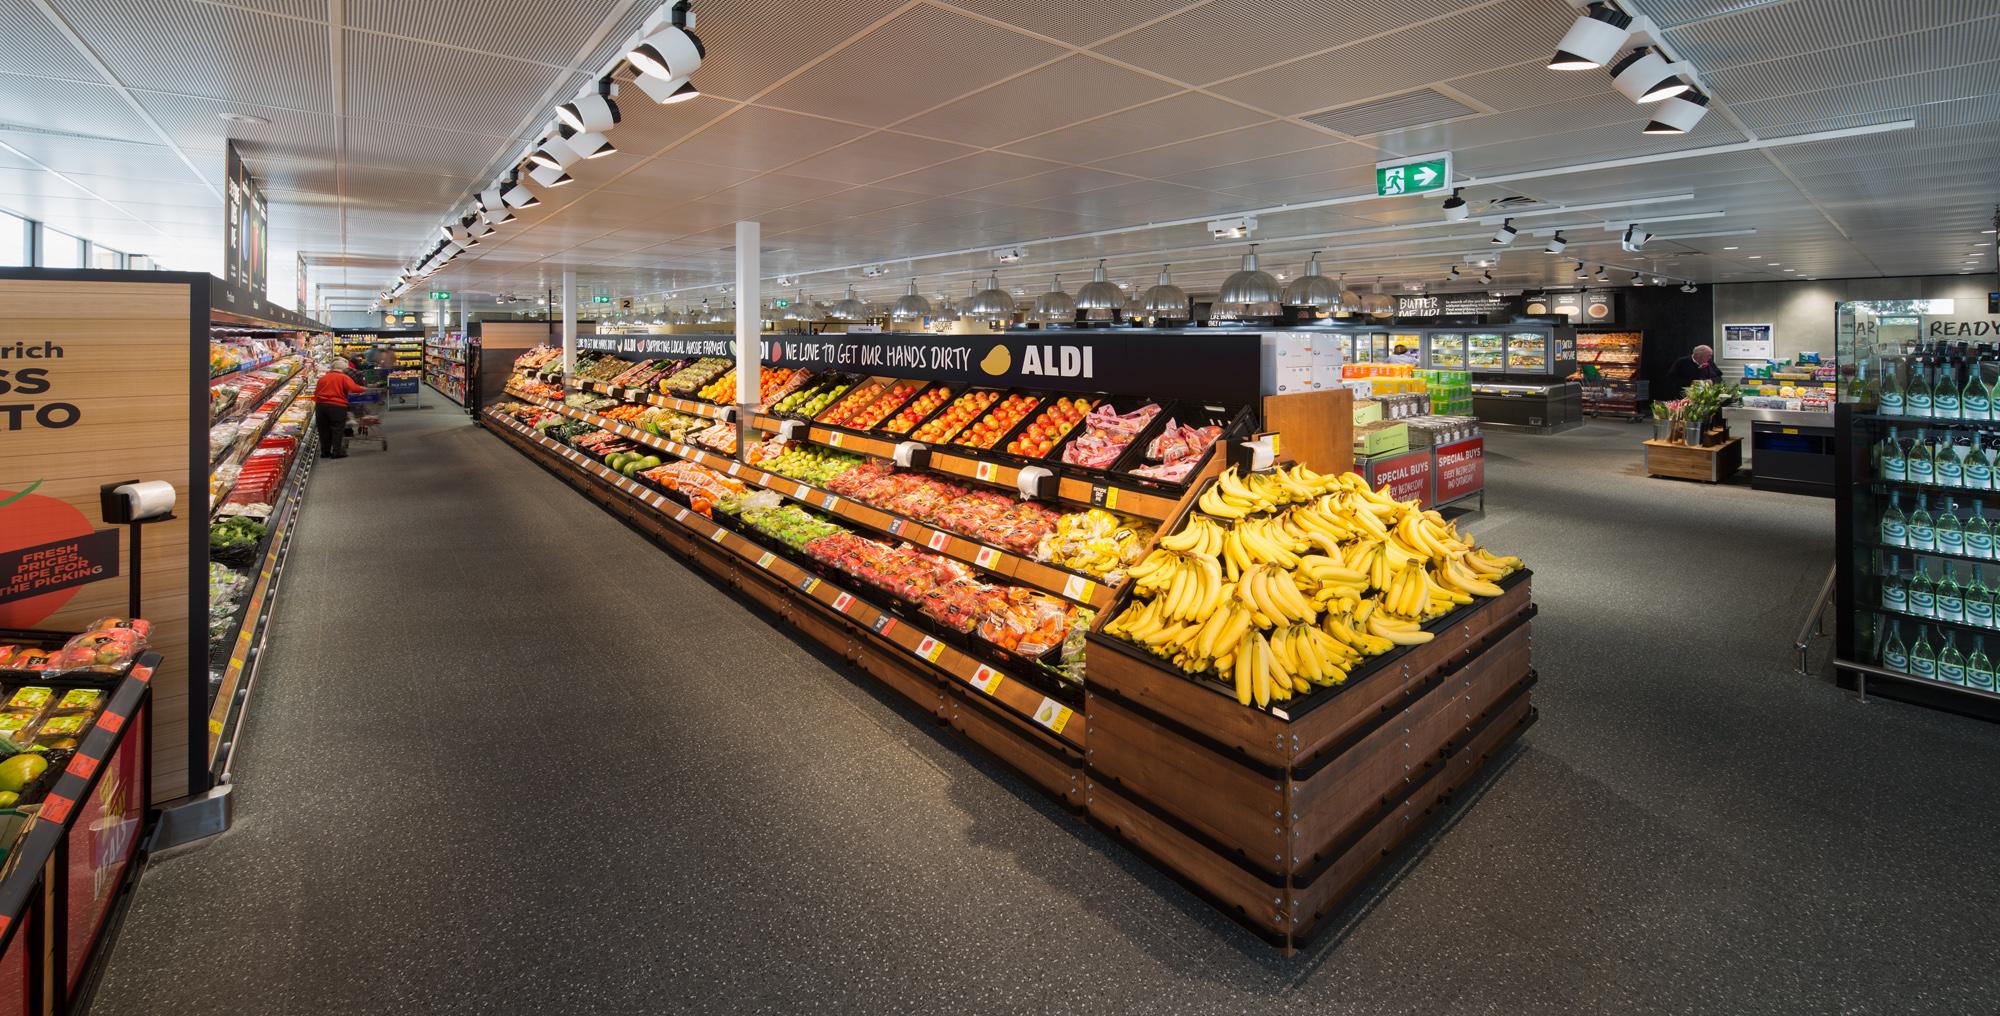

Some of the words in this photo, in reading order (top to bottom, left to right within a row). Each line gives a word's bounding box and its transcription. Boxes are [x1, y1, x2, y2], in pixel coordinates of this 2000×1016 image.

[623, 300, 631, 308] 2
[1400, 297, 1438, 309] BUTTER
[623, 339, 636, 352] ALDI
[785, 341, 798, 361] WE
[799, 341, 820, 363] LOVE
[823, 343, 835, 364] TO
[837, 344, 858, 365] GET
[861, 344, 884, 367] OUR
[886, 345, 926, 369] HANDS
[931, 346, 971, 372] DIRTY
[1021, 345, 1093, 378] ALDI
[1438, 452, 1465, 467] SPECIAL
[1465, 447, 1481, 459] BUYS
[1377, 467, 1408, 485] SPECIAL
[1410, 461, 1429, 476] BUYS
[17, 553, 84, 574] PRICES,
[22, 543, 79, 563] FRESH
[0, 582, 31, 597] THE
[34, 565, 104, 589] PICKING
[10, 568, 51, 585] RIPE
[54, 559, 89, 576] FOR
